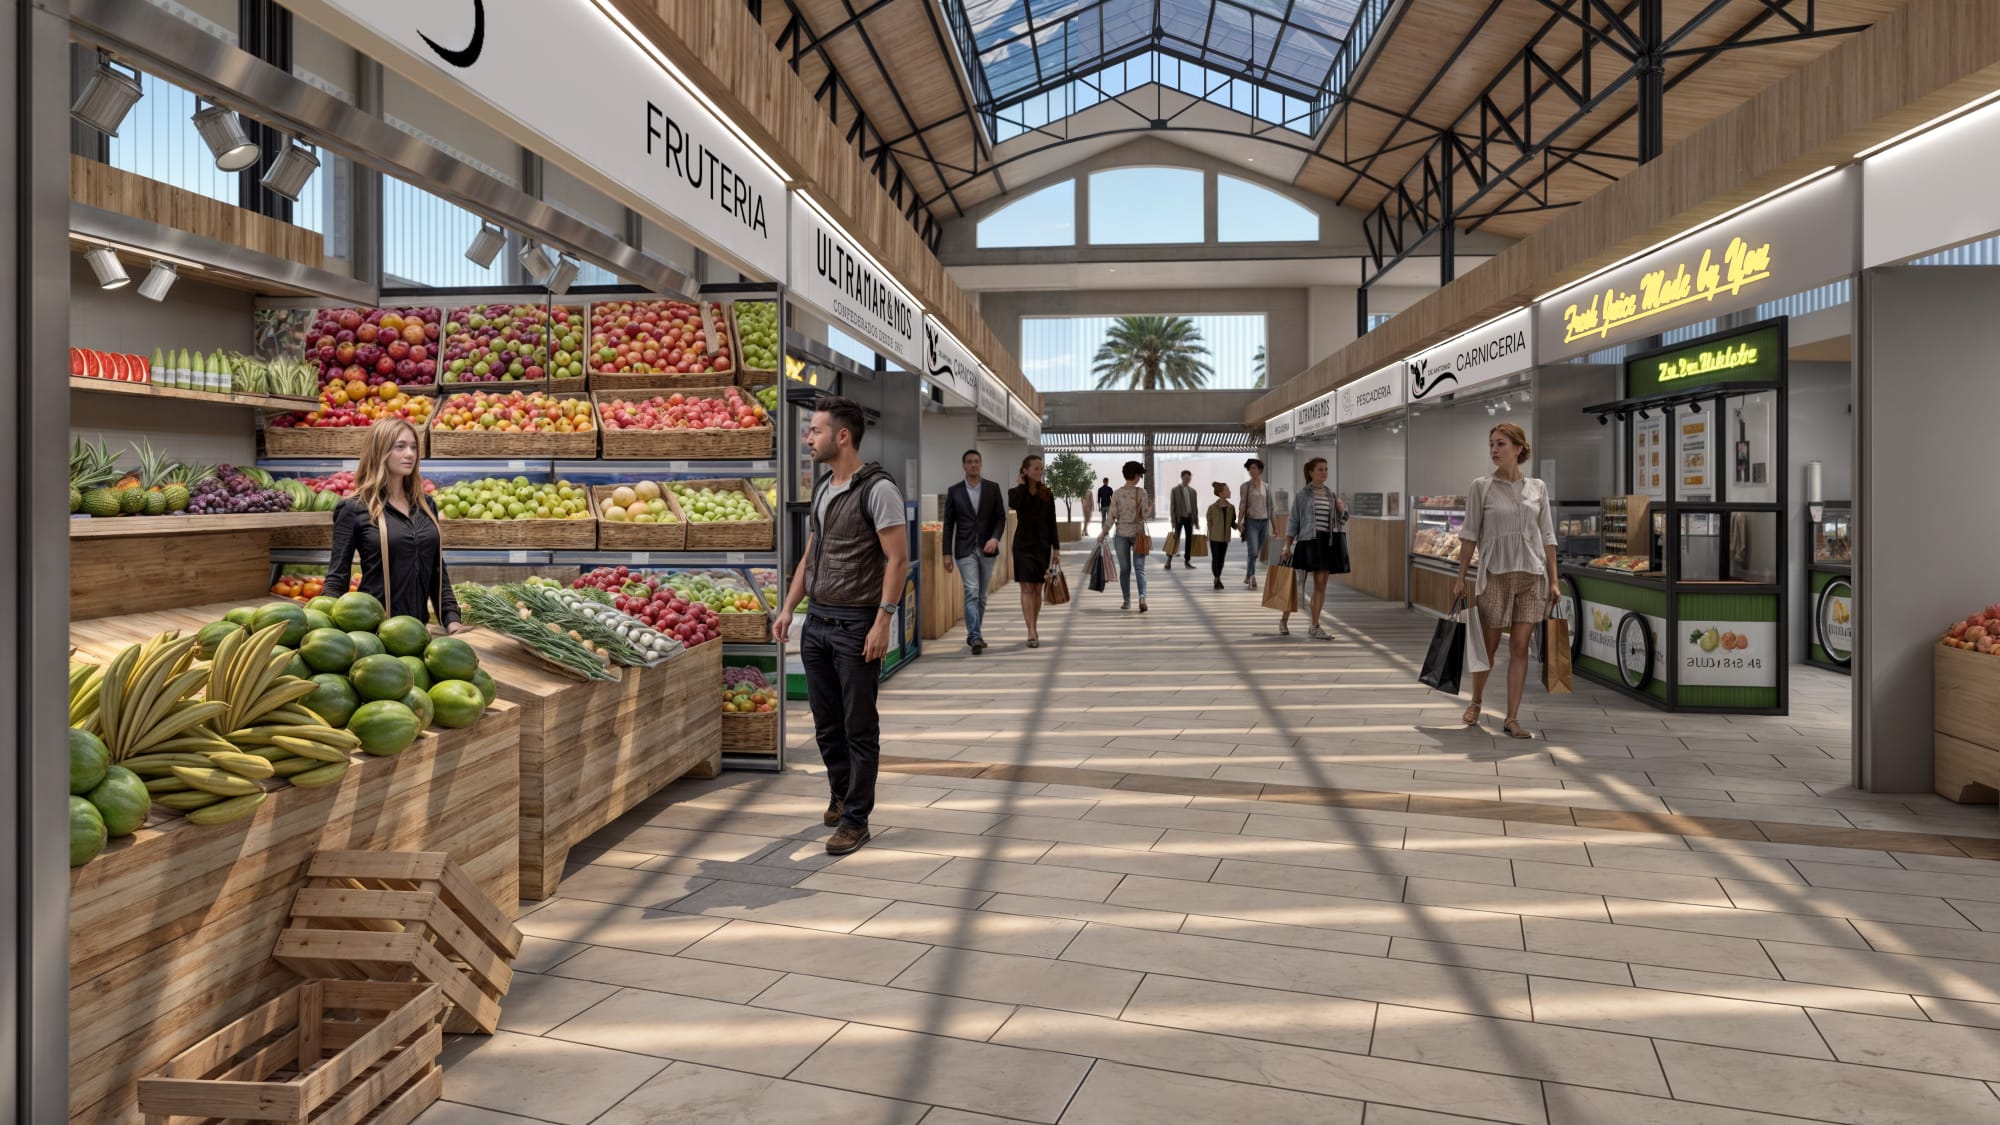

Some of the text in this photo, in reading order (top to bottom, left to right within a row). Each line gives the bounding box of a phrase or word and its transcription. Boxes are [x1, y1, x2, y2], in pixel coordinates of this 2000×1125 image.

[646, 100, 769, 239] FRUTERIA
[1640, 263, 1691, 310] Made
[1696, 248, 1721, 301] by
[1724, 236, 1771, 295] You
[1456, 330, 1526, 372] CARNICERIA
[1356, 383, 1392, 408] PESCADERIA
